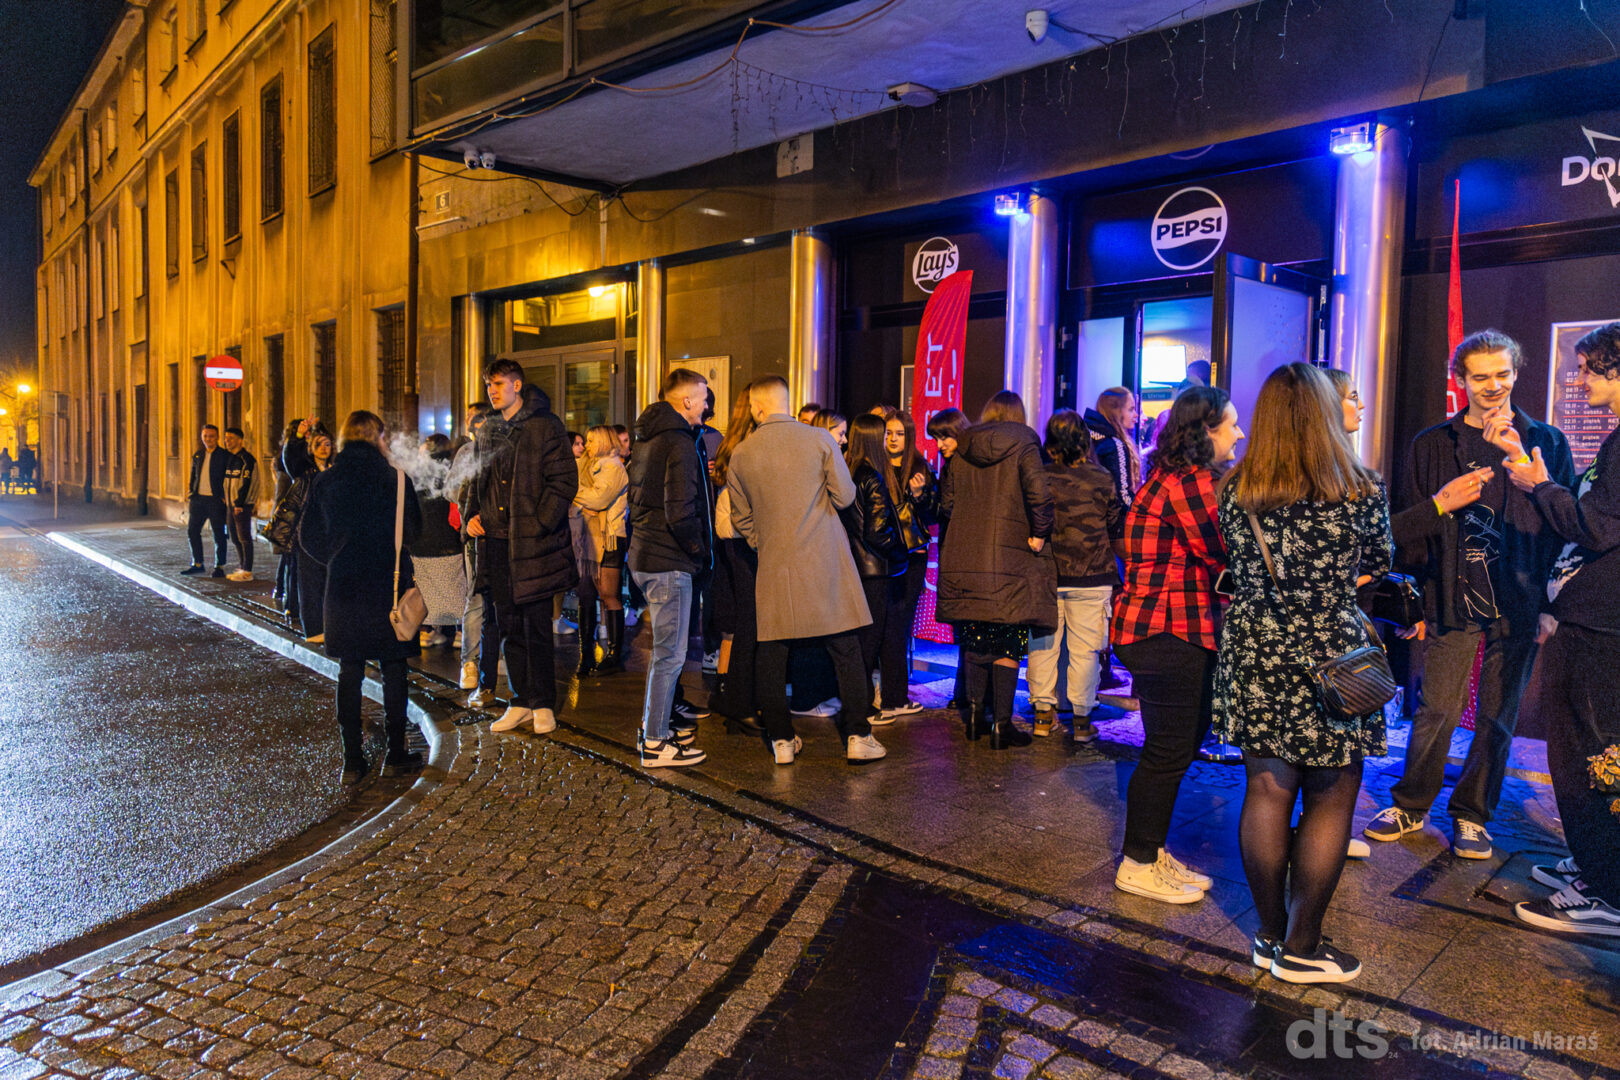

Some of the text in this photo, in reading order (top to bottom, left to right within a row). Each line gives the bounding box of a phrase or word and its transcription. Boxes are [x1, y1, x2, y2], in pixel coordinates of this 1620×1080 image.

[1561, 155, 1620, 187] DO
[1156, 216, 1222, 241] PEPSI
[916, 248, 957, 281] Lay's
